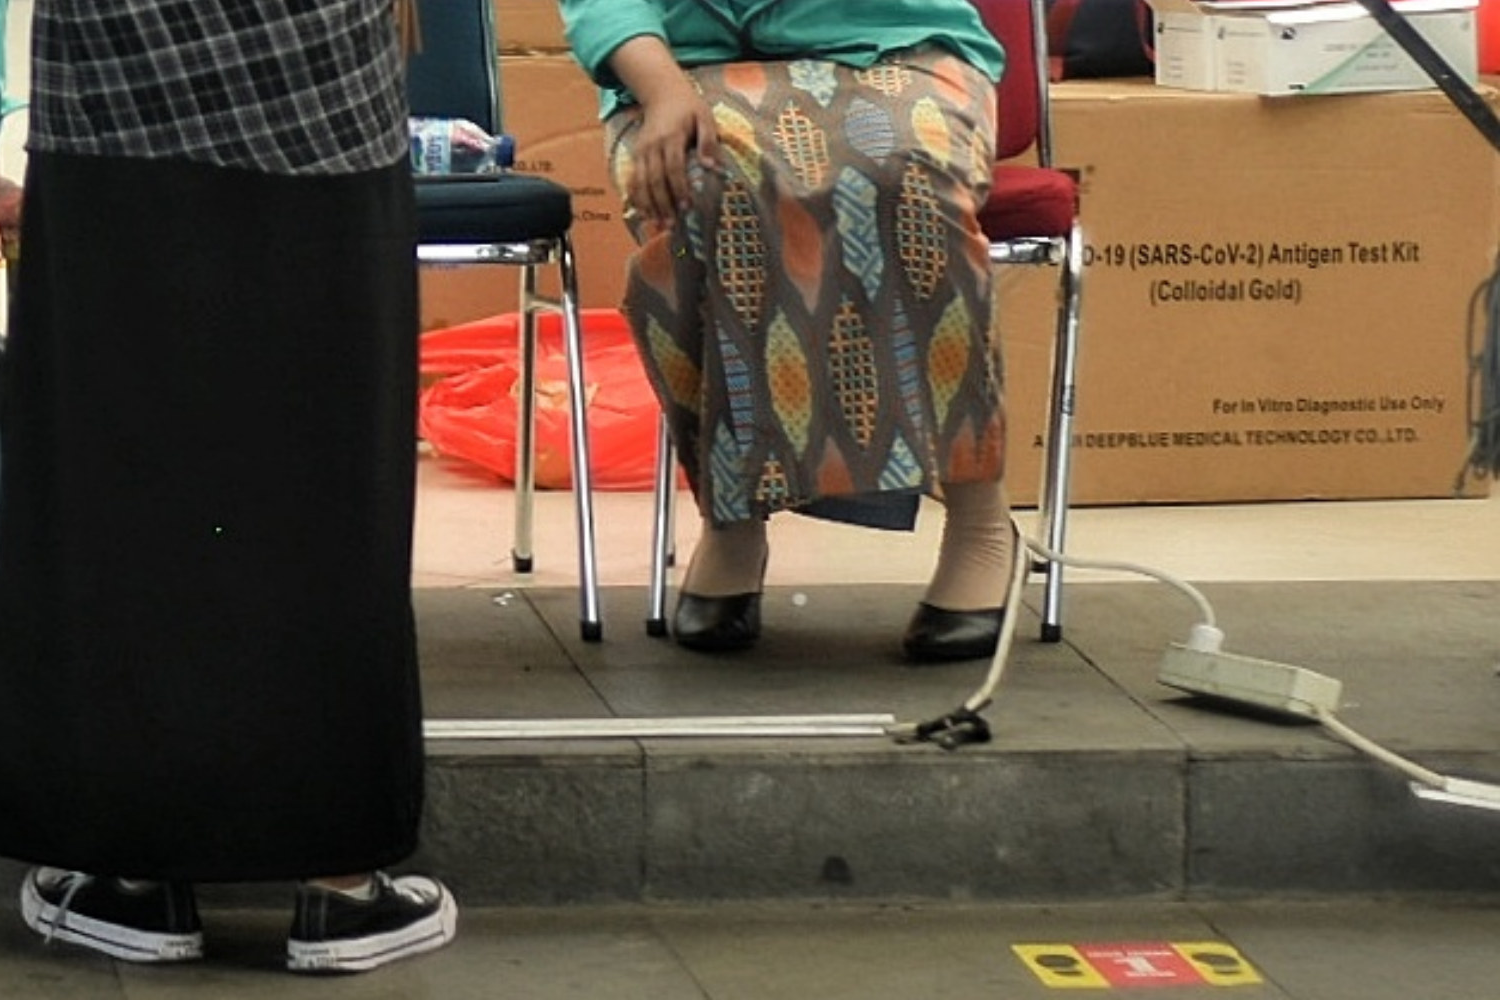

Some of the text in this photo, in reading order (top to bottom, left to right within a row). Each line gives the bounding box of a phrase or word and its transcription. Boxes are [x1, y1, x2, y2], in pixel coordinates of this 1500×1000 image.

[1129, 243, 1262, 271] (SARS-CoV-2)
[1267, 243, 1343, 270] Antigen
[1347, 242, 1388, 264] Test
[1392, 242, 1420, 263] Kit
[1149, 279, 1303, 306] (Colloidal Gold)
[1212, 395, 1444, 416] For In Vitro Diagnostic Use Only
[1085, 432, 1170, 449] DEEPBLUE
[1172, 431, 1241, 447] MEDICAL
[1245, 429, 1351, 446] TECHNOLOGY
